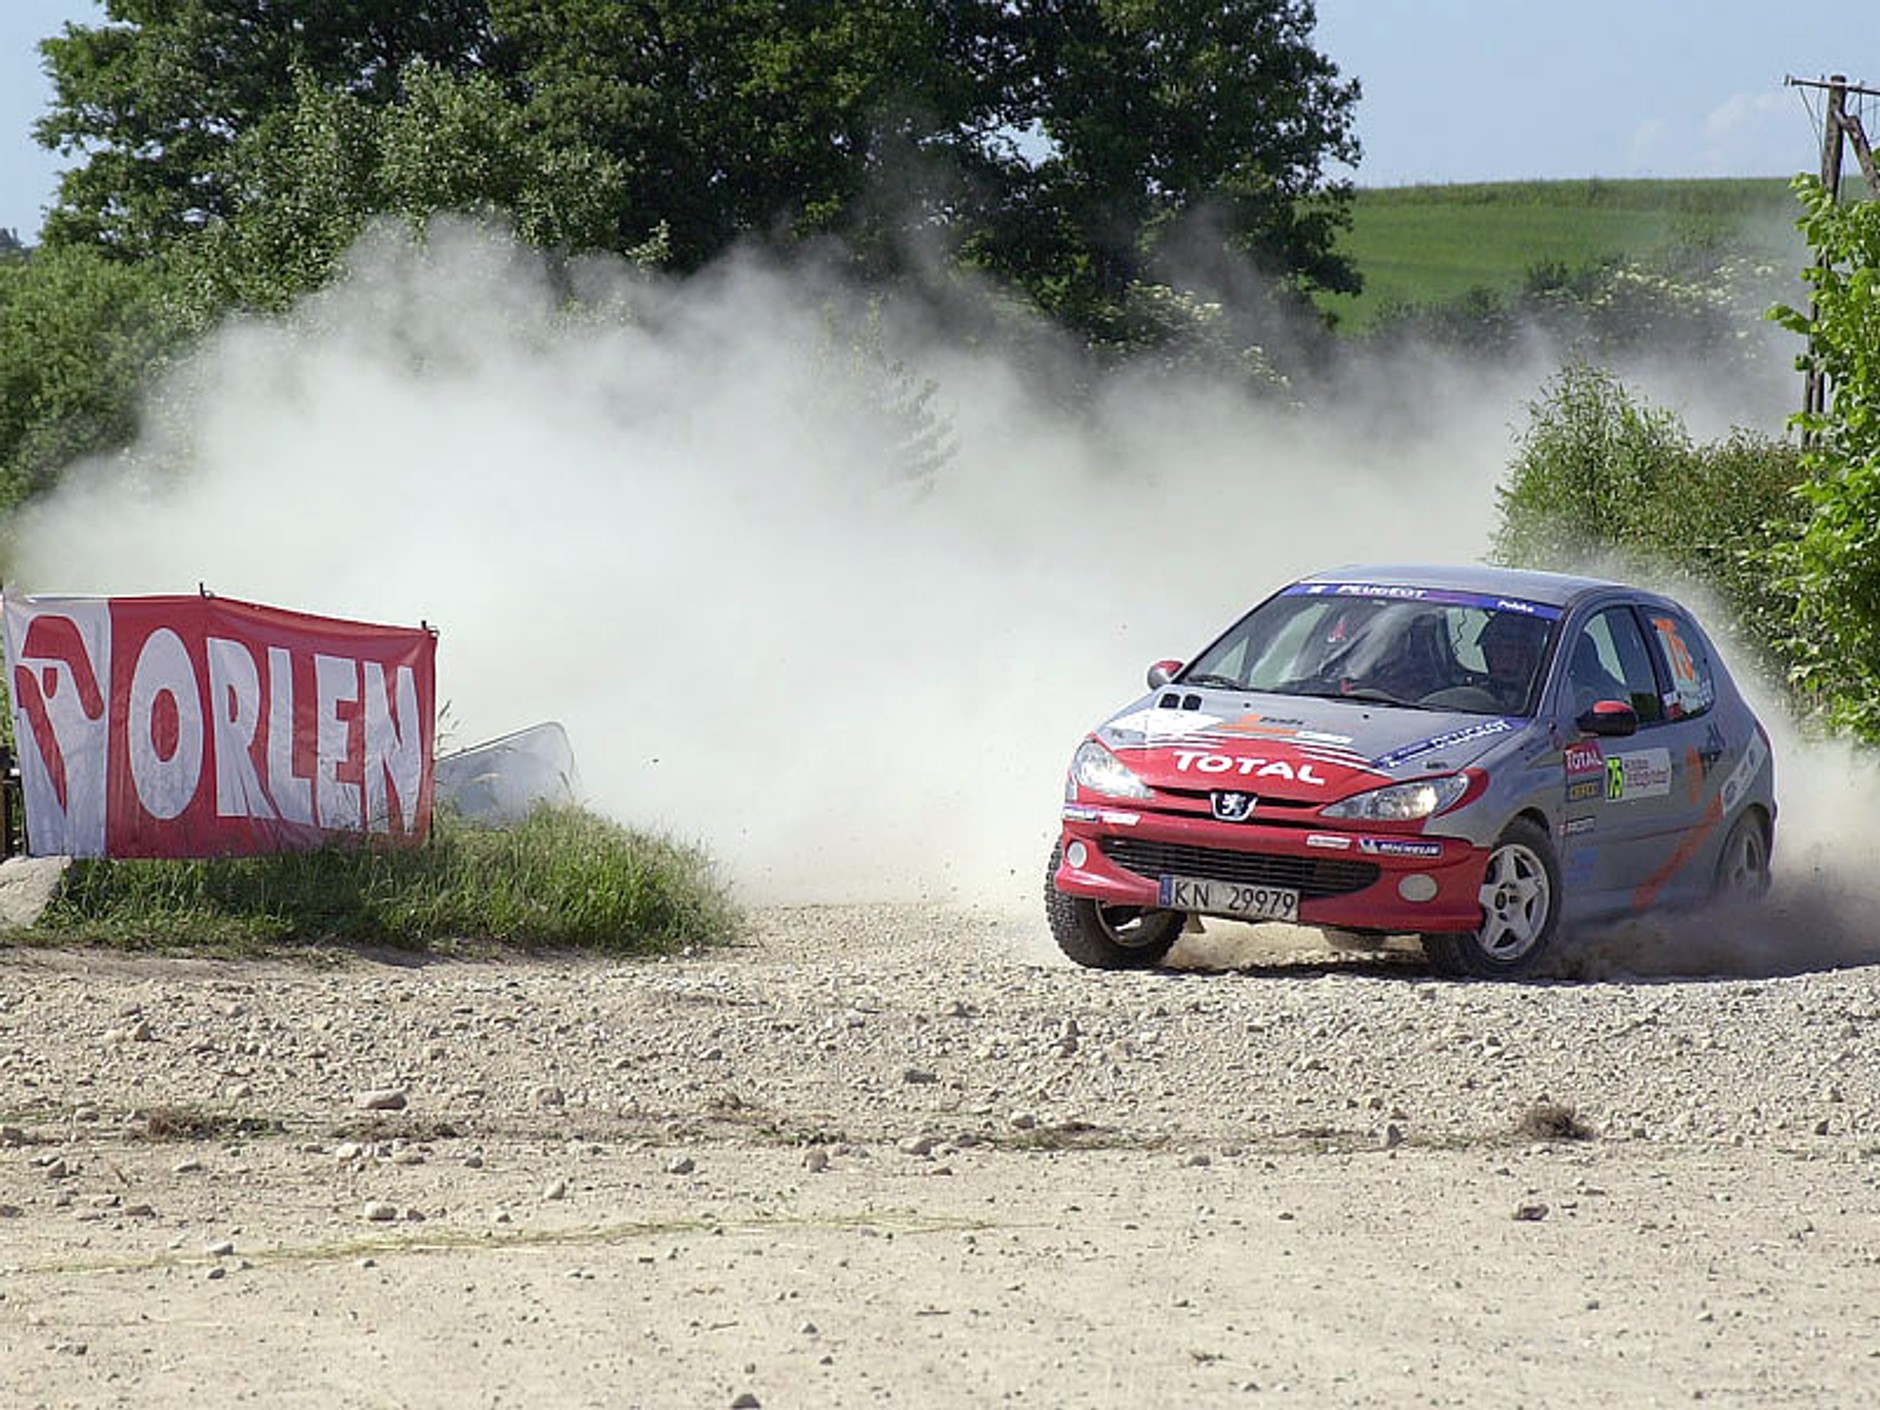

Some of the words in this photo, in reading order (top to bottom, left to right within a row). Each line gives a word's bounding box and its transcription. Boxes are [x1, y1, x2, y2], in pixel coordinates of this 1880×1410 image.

[128, 627, 423, 834] ORLEN
[1172, 750, 1326, 786] TOTAL
[1564, 748, 1603, 771] TOTAL
[1174, 881, 1210, 908] KN
[1228, 886, 1296, 917] 29979
